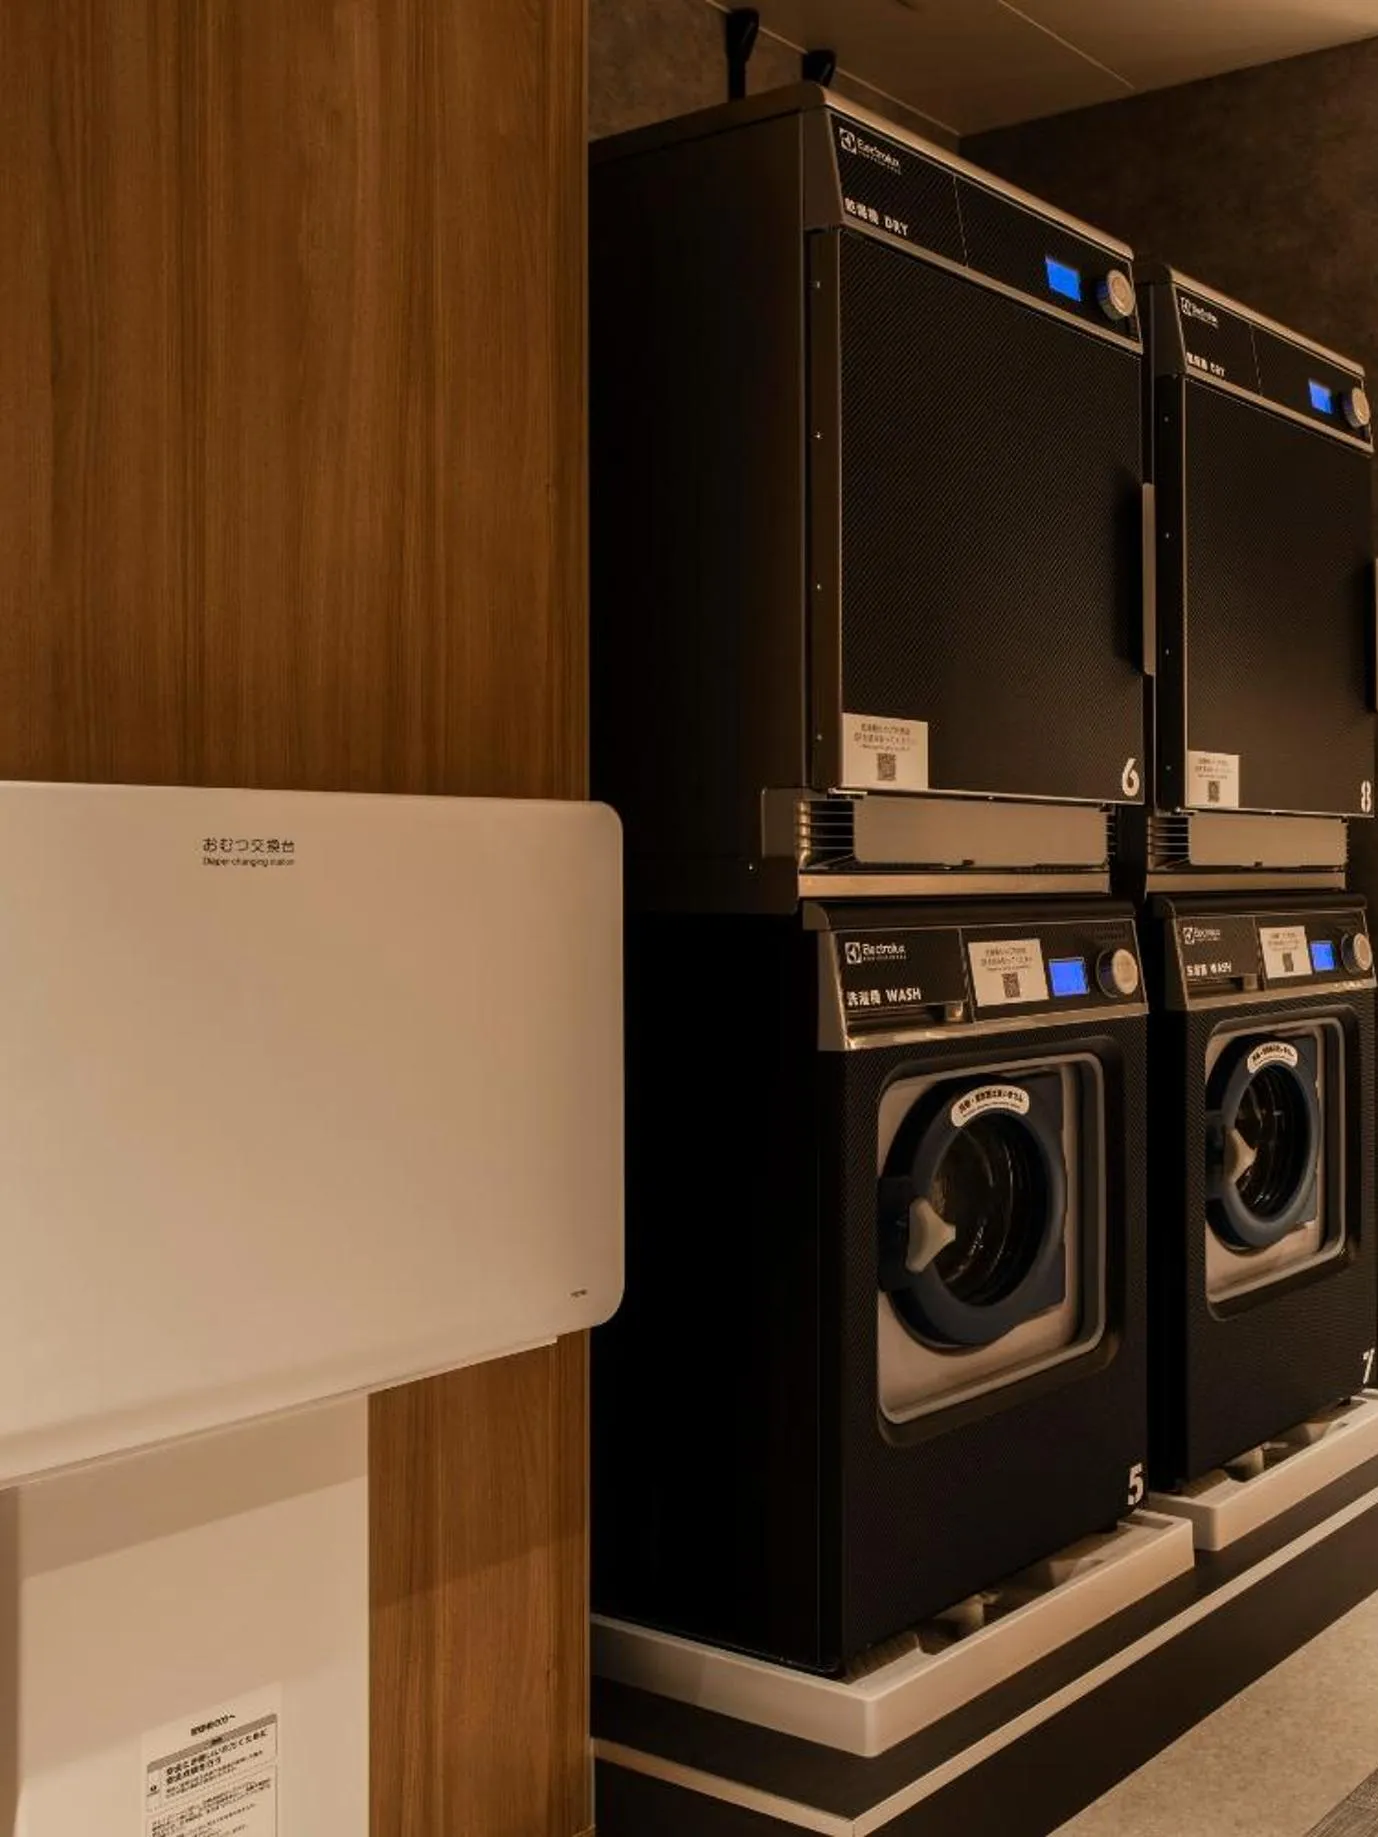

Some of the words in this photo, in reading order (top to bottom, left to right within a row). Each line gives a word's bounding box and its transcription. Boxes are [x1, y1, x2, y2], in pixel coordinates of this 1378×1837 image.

[1121, 757, 1140, 797] 6
[1360, 780, 1372, 813] 8
[202, 837, 295, 853] おむつ交換台
[885, 987, 922, 1003] WASH
[1362, 1348, 1375, 1385] 7
[1127, 1463, 1144, 1506] 5
